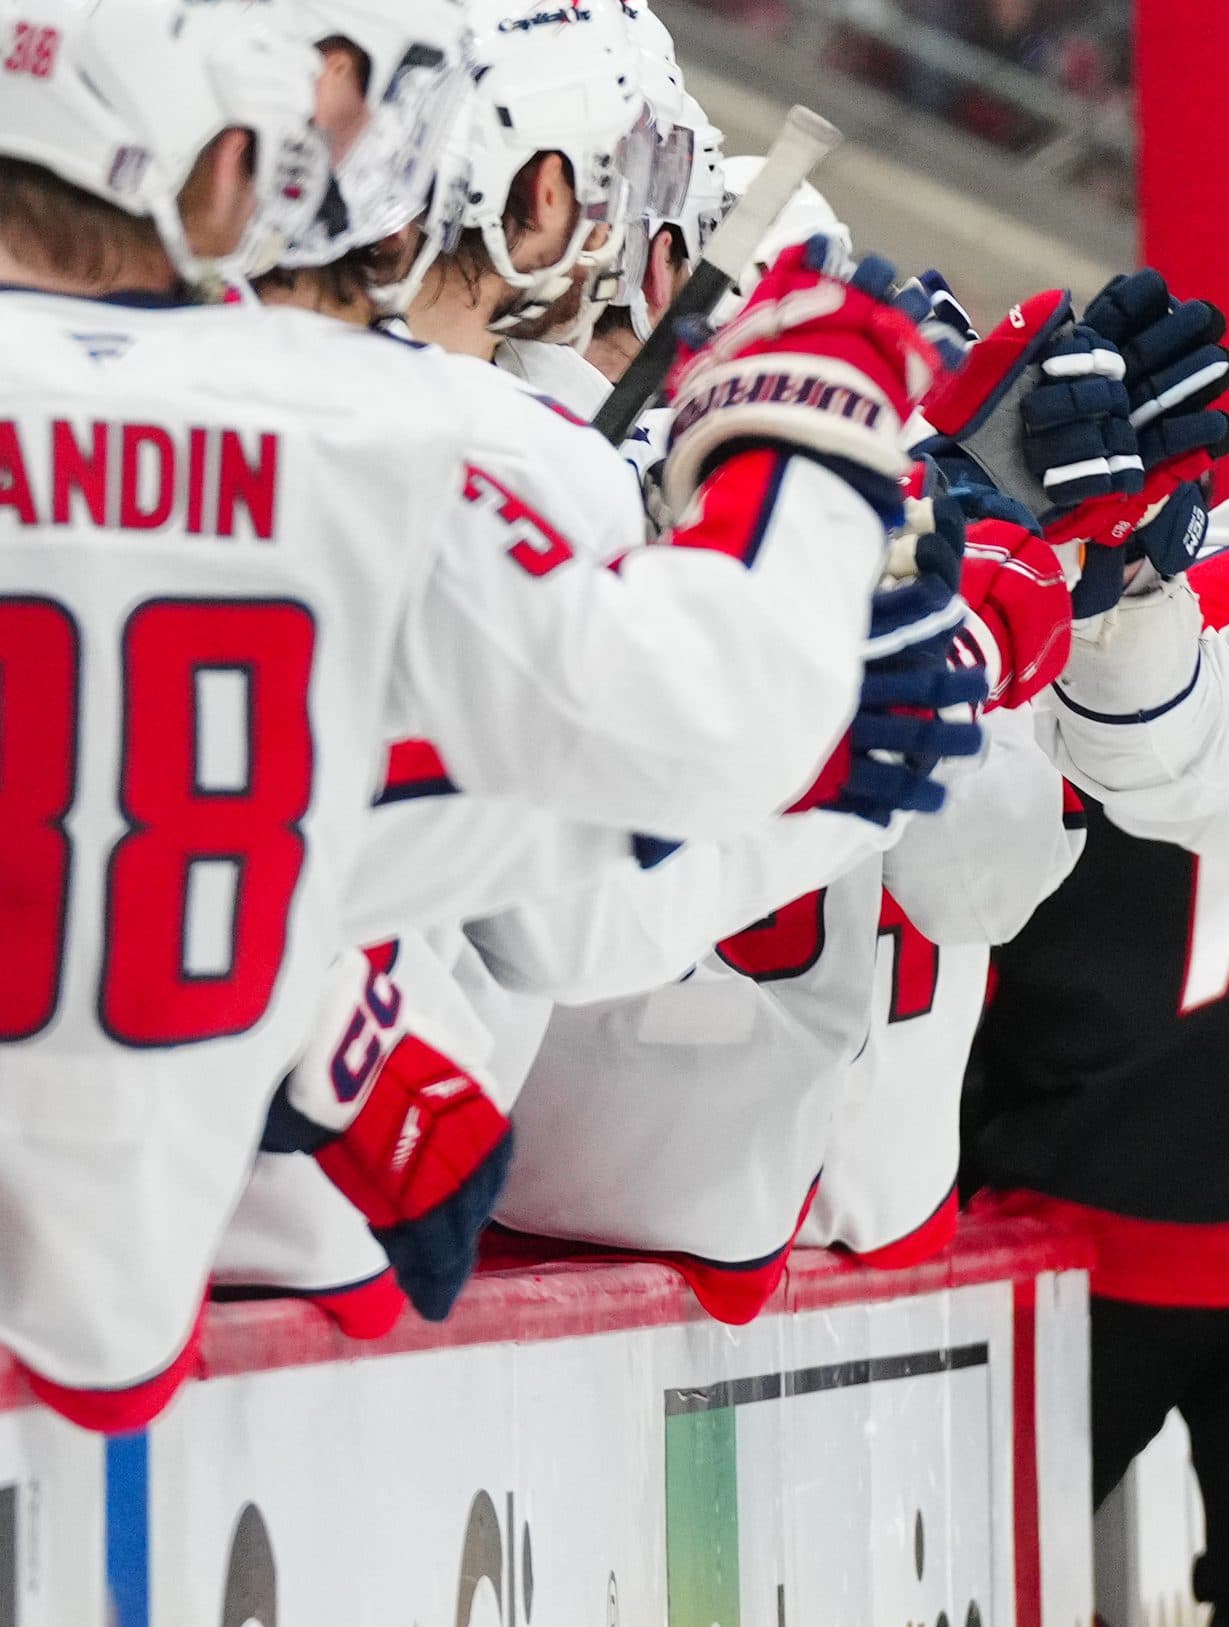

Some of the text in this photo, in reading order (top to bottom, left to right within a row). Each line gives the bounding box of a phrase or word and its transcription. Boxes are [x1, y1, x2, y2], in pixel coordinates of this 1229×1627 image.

[5, 22, 61, 78] 38
[0, 420, 278, 540] ANDIN
[330, 970, 402, 1104] CC
